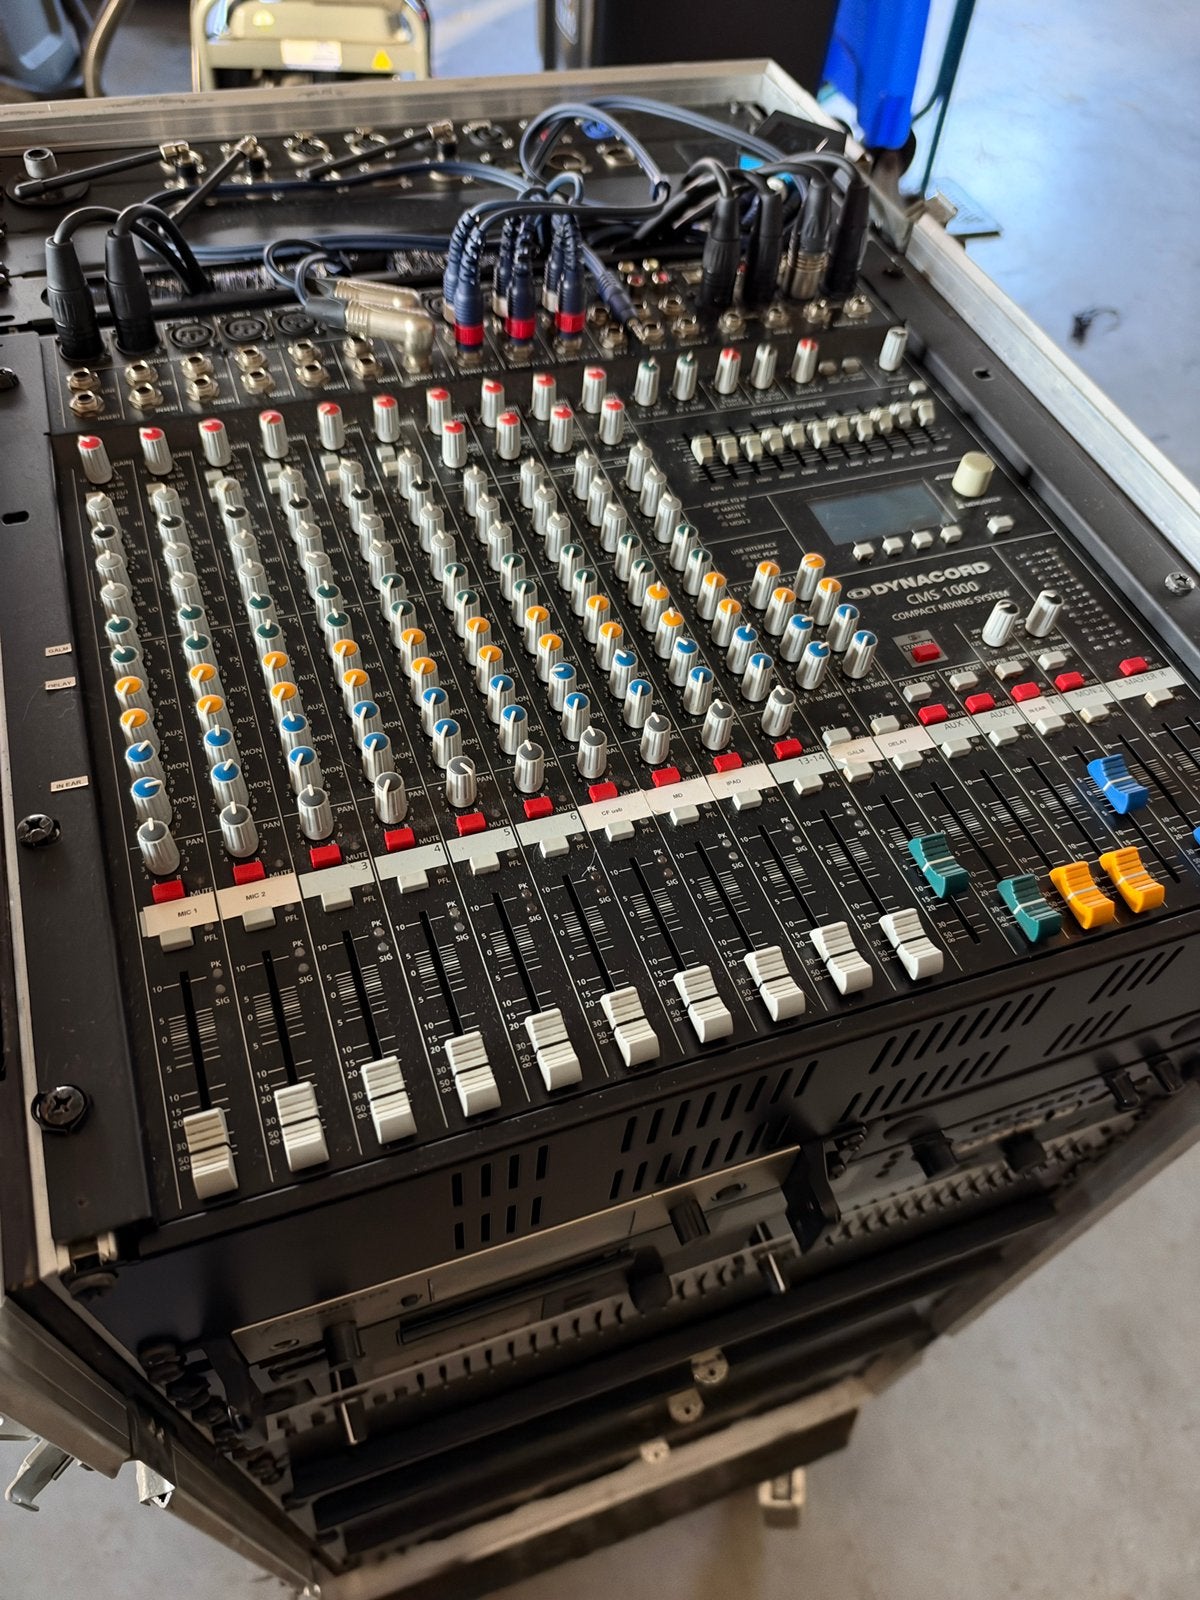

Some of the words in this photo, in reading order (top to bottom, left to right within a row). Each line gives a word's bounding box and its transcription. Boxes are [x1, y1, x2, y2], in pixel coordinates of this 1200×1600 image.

[744, 542, 777, 552] INTERFACE
[764, 550, 780, 558] PEAK
[870, 562, 992, 596] DYNACORD
[906, 588, 940, 605] CMS
[942, 581, 979, 598] 1000
[892, 605, 937, 622] COMPACT
[940, 598, 971, 612] MIXING
[972, 590, 1010, 606] SYSTEM
[364, 662, 382, 670] AUX
[964, 664, 982, 672] POST
[298, 673, 316, 682] AUX
[899, 679, 914, 687] AUX
[920, 674, 936, 682] POST
[1125, 674, 1154, 686] MASTER
[1159, 670, 1166, 678] R
[47, 680, 72, 688] DELAY
[872, 680, 889, 688] MON
[230, 686, 248, 694] AUX
[1074, 688, 1096, 698] MON
[374, 690, 392, 699] AUX
[824, 690, 842, 700] MON
[159, 698, 177, 706] AUX
[307, 703, 324, 712] AUX
[990, 710, 1009, 720] AUX
[237, 716, 255, 724] AUX
[944, 720, 963, 731] AUX
[164, 729, 183, 738] AUX
[312, 734, 333, 743] MON
[888, 739, 908, 748] DELAY
[241, 748, 262, 757] MON
[392, 752, 412, 762] MON
[798, 755, 826, 766] 13-14
[167, 762, 190, 771] MON
[322, 766, 342, 776] MON
[65, 780, 82, 788] EAR
[248, 780, 270, 790] MON
[408, 790, 425, 799] PAN
[173, 795, 196, 805] MON
[337, 806, 354, 814] PAN
[556, 804, 576, 812] MUTE
[570, 812, 576, 820] 6
[262, 820, 280, 830] PAN
[488, 819, 510, 828] MUTE
[504, 828, 510, 836] 5
[642, 826, 654, 834] PFL
[186, 837, 204, 846] PAN
[418, 834, 440, 844] MUTE
[434, 844, 441, 852] 4
[346, 851, 368, 862] MUTE
[362, 862, 368, 870] 3
[508, 860, 522, 868] PFL
[518, 882, 528, 890] PK
[666, 878, 679, 886] SIG
[190, 886, 214, 896] MUTE
[246, 893, 260, 901] MIC
[599, 896, 612, 904] SIG
[178, 910, 192, 918] MIC
[284, 915, 299, 923] PFL
[528, 915, 542, 923] SIG
[456, 934, 470, 942] SIG
[379, 954, 394, 962] SIG
[210, 960, 222, 968] PK
[298, 975, 314, 984] SIG
[658, 978, 668, 986] 20
[216, 996, 230, 1006] SIG
[502, 1000, 512, 1008] 10
[666, 998, 676, 1006] 30
[506, 1012, 516, 1020] 15
[509, 1022, 520, 1030] 20
[342, 1046, 352, 1054] 10
[516, 1042, 526, 1050] 30
[345, 1059, 356, 1067] 15
[348, 1070, 358, 1078] 20
[169, 1094, 180, 1102] 10
[352, 1091, 363, 1100] 30
[171, 1109, 182, 1117] 15
[172, 1120, 184, 1128] 20
[176, 1142, 188, 1150] 30
